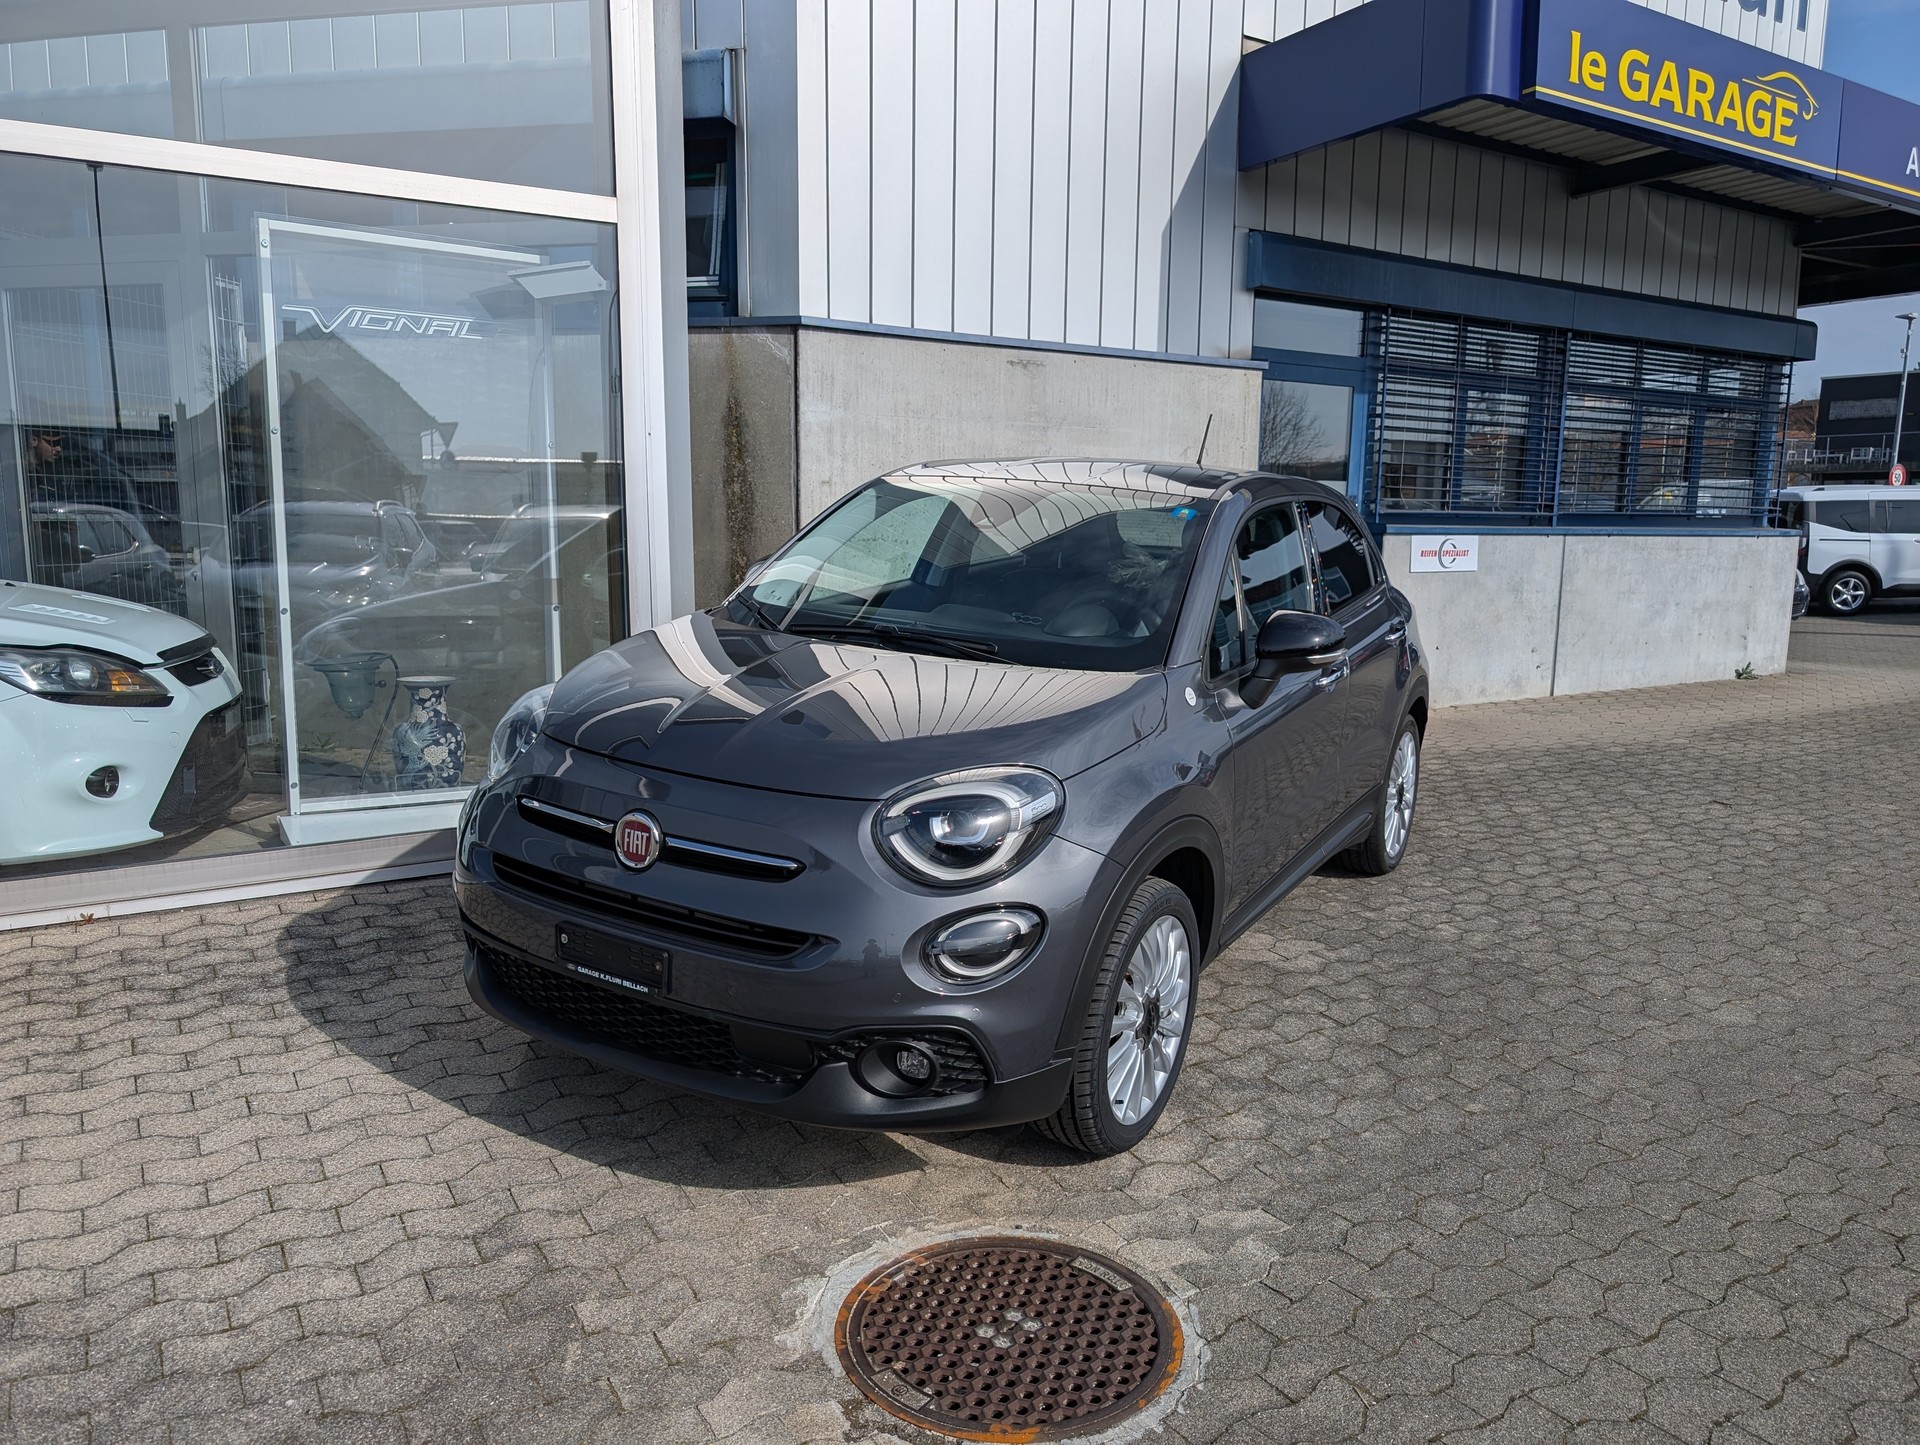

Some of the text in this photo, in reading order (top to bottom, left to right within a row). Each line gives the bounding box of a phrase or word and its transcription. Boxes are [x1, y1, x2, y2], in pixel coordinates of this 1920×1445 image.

[1568, 30, 1798, 147] le GARAGE
[282, 304, 500, 341] VIGNAL
[1420, 549, 1469, 558] REIFEN SPEZIALIST
[624, 828, 649, 856] FIAT
[577, 966, 600, 978] GARAGE
[622, 980, 649, 993] BELLACH
